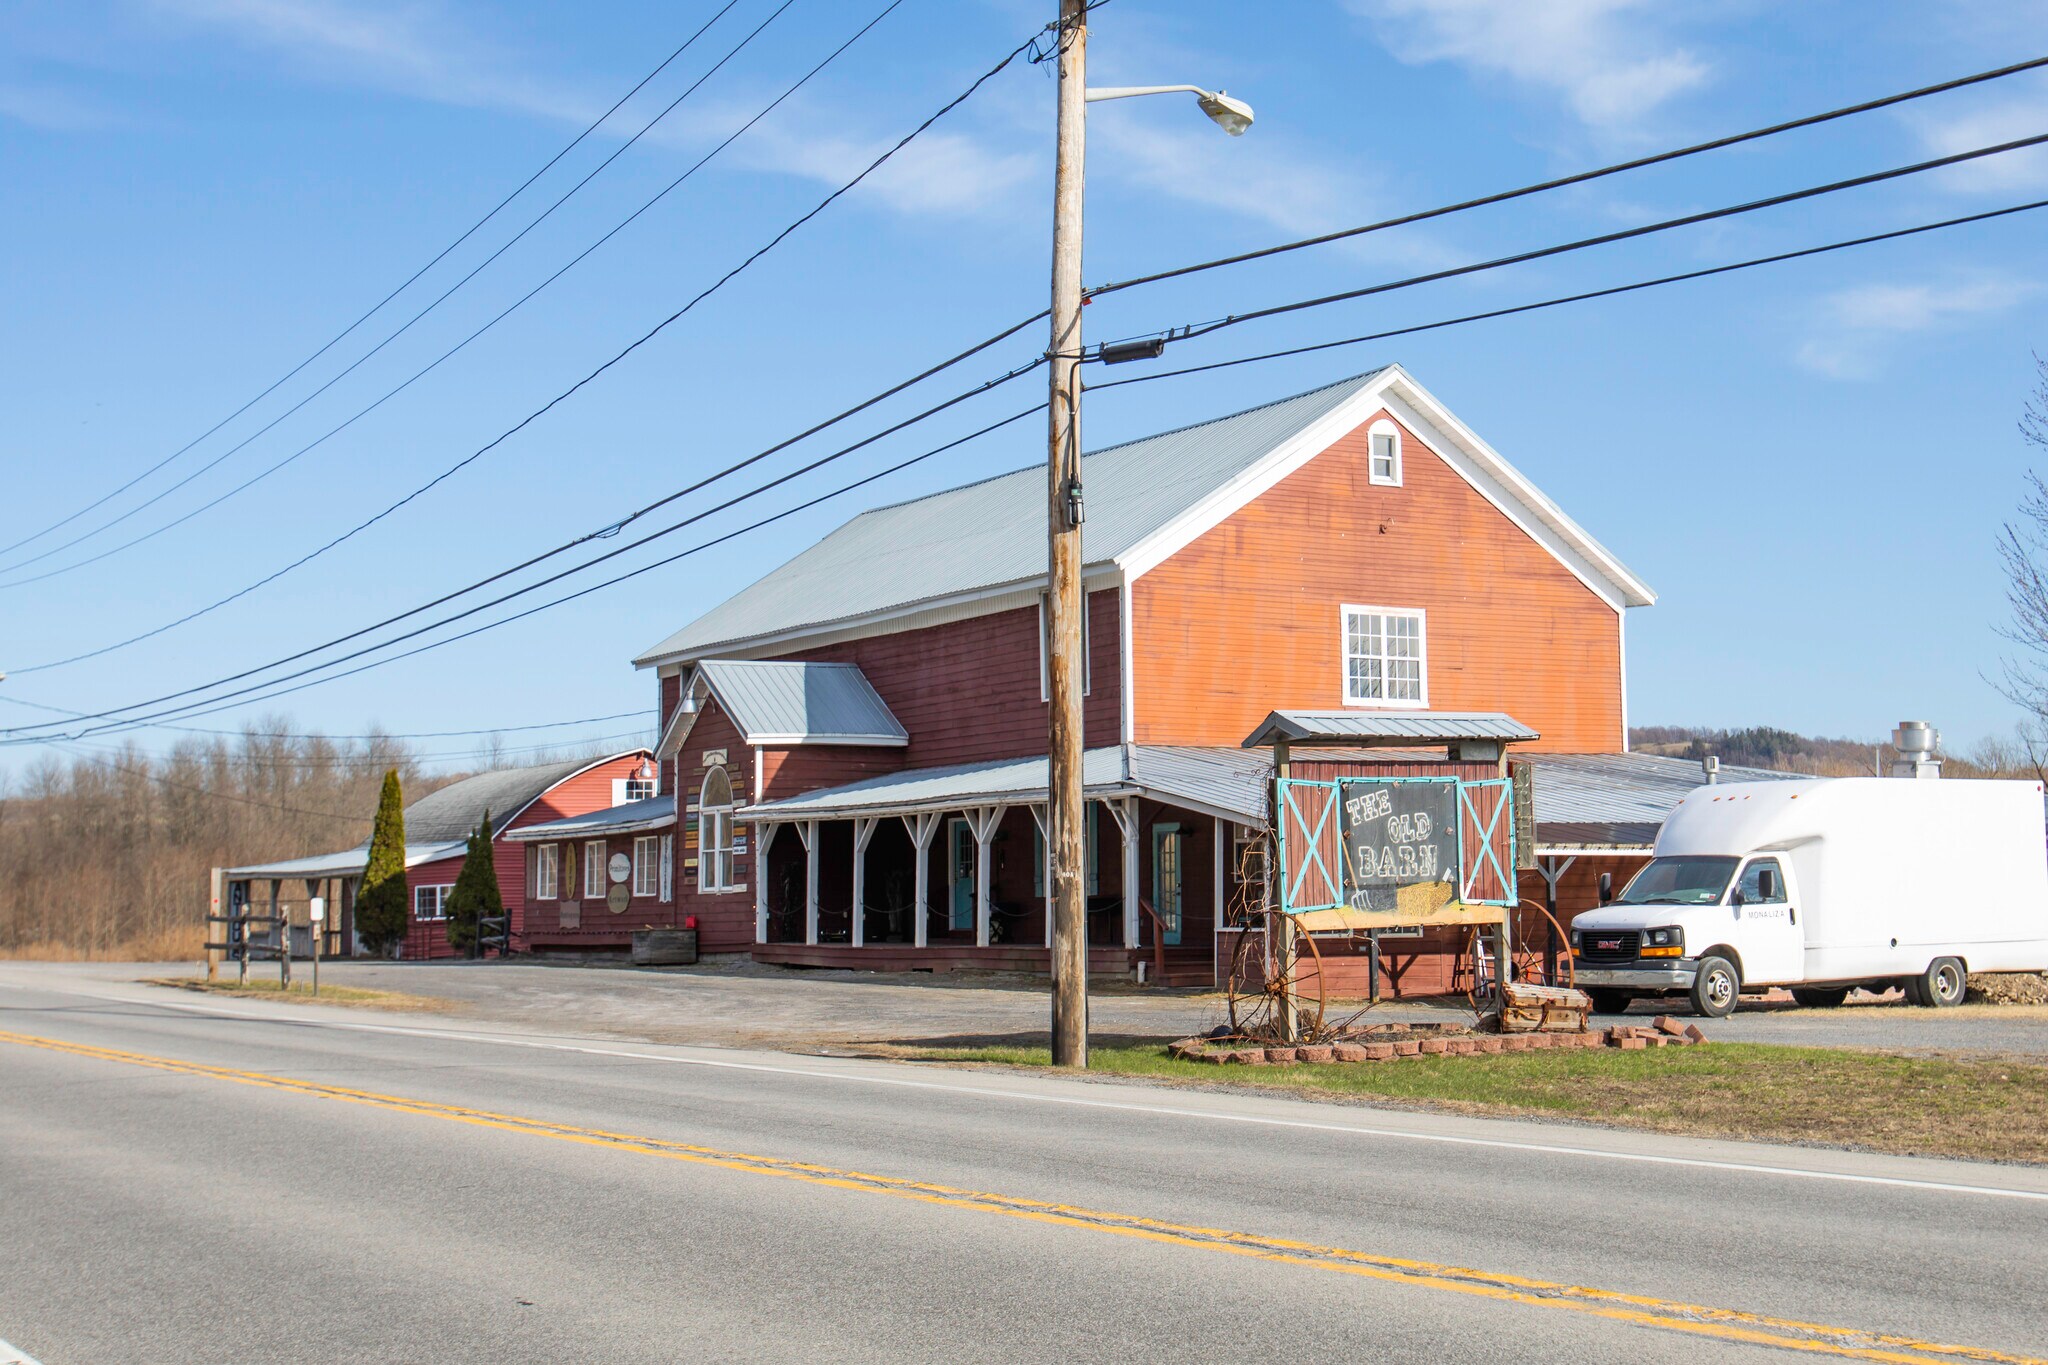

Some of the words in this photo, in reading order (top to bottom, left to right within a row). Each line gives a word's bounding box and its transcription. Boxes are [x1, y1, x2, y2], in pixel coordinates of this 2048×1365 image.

[1346, 789, 1392, 826] THE
[1388, 812, 1433, 843] OLD
[1358, 844, 1438, 877] BARN
[1748, 910, 1785, 919] MONALIZA
[1597, 940, 1620, 949] GMC
